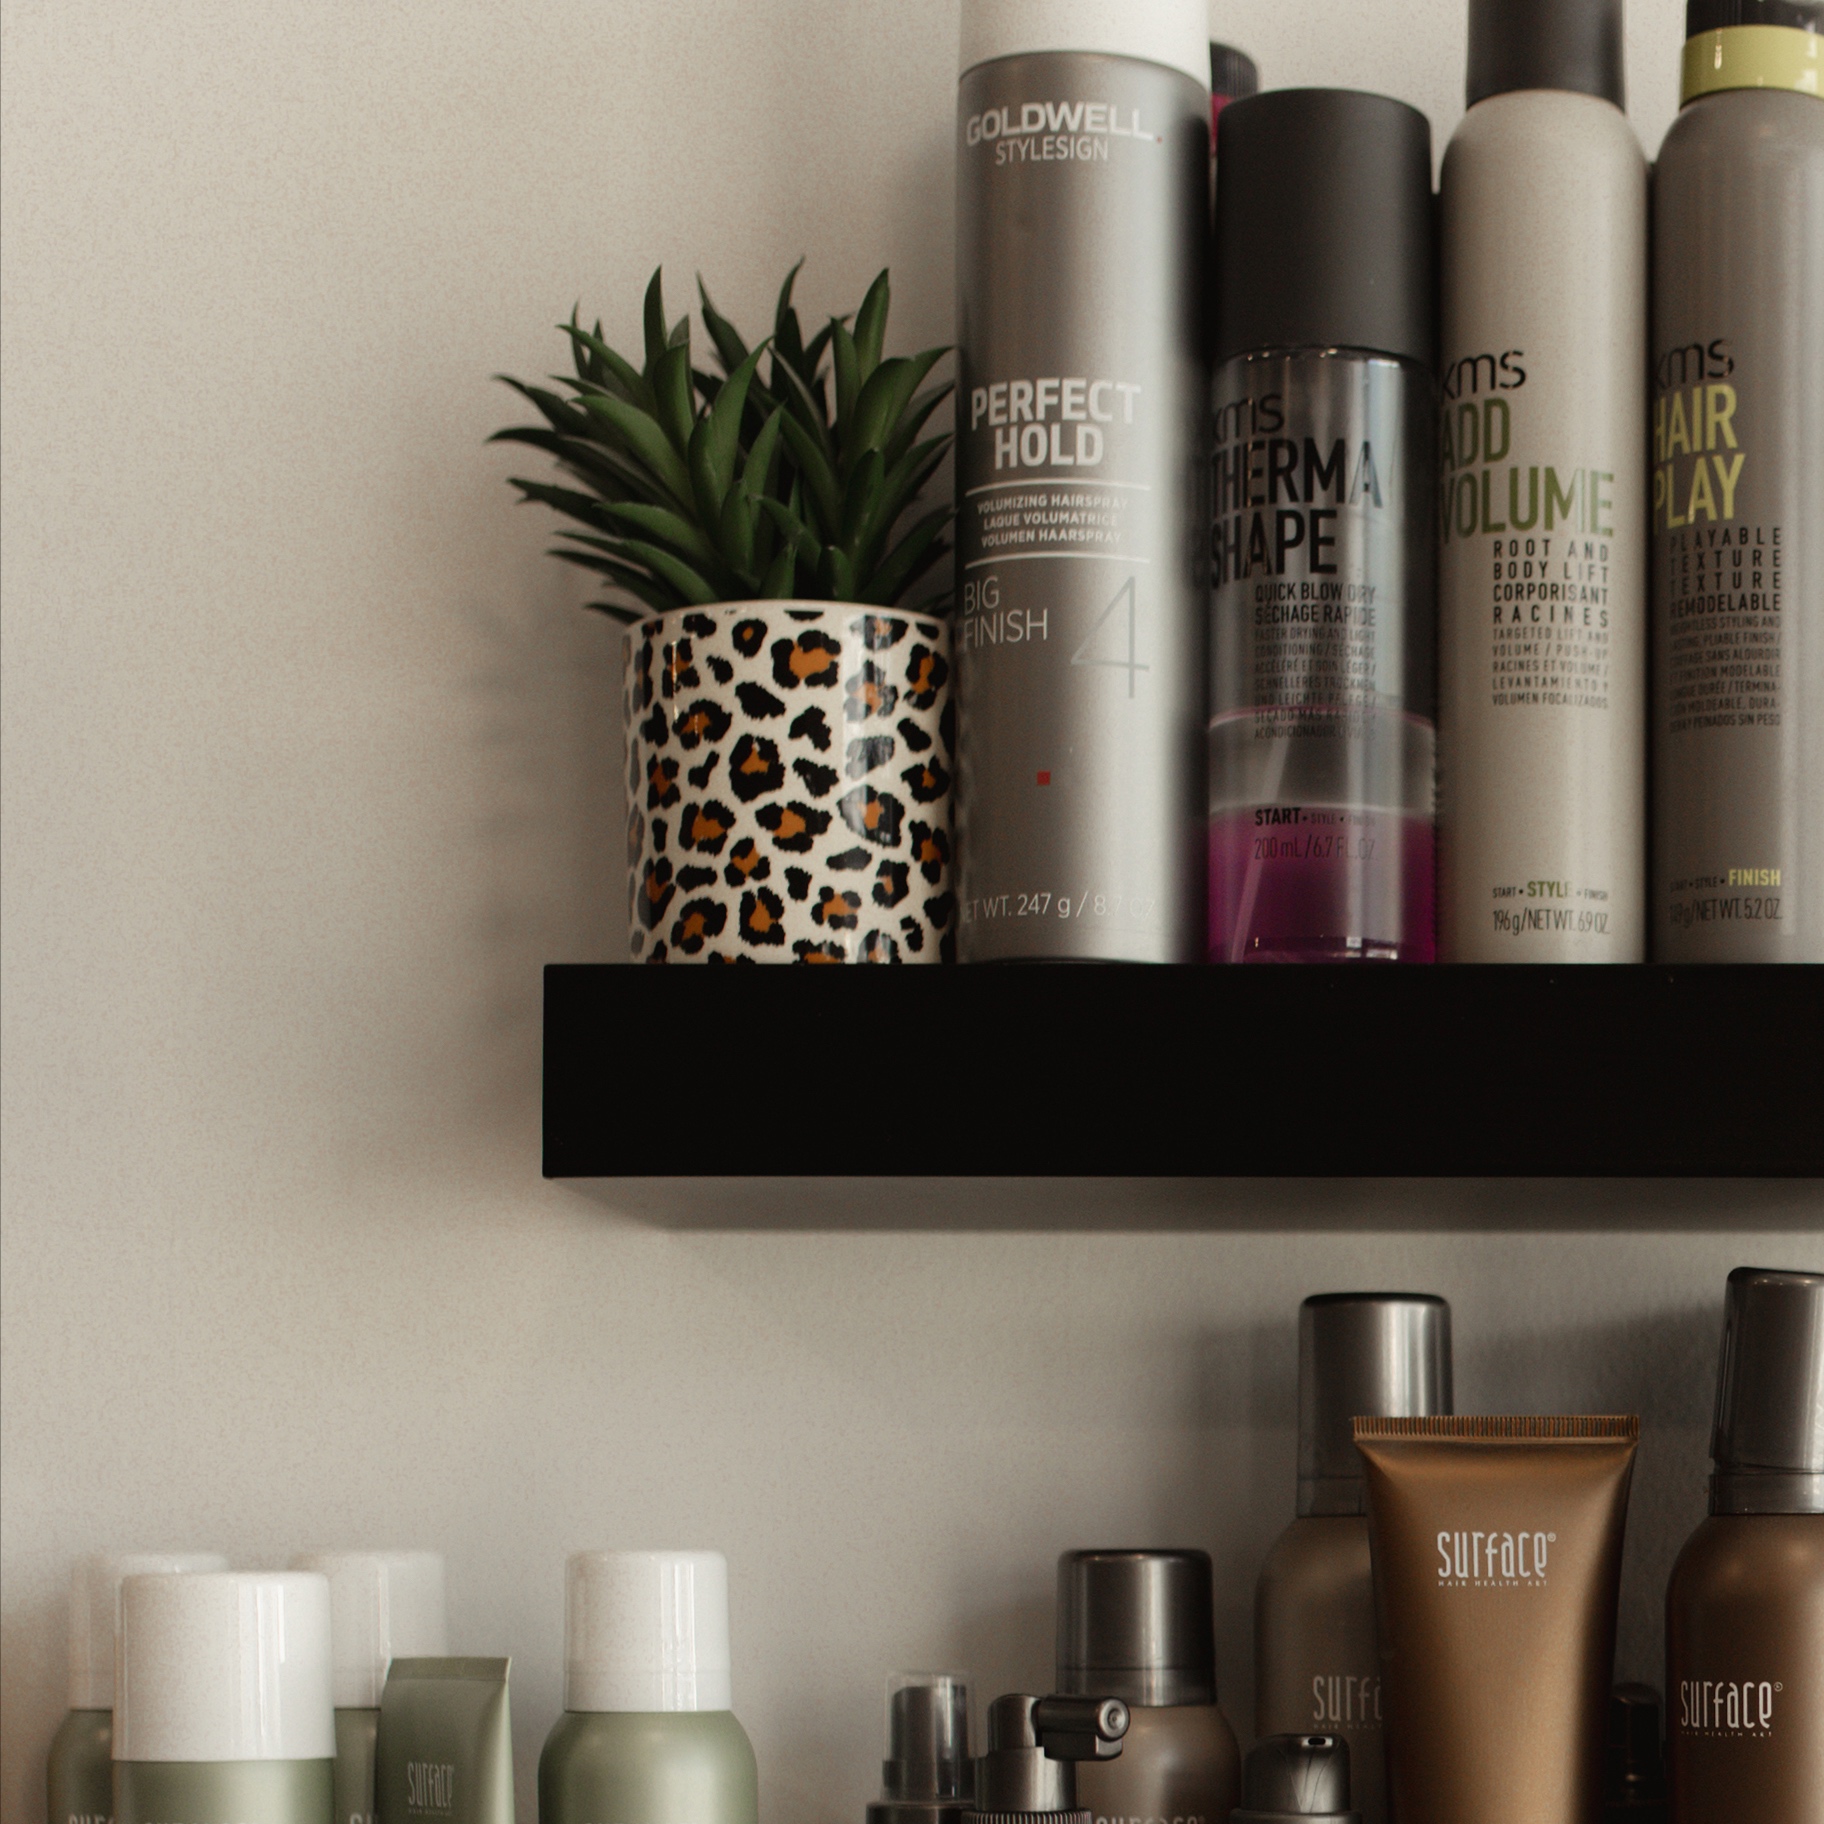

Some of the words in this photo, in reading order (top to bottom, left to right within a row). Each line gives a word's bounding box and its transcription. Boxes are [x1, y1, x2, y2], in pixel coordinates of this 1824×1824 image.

[966, 102, 1154, 146] GOLDWELL
[994, 135, 1109, 166] STYLESIGN
[971, 377, 1142, 431] PERFECT
[1442, 397, 1511, 471] ADD
[1653, 382, 1739, 462] HAIR
[994, 422, 1104, 470] HOLD
[1212, 436, 1384, 519] THERMA
[977, 494, 1047, 514] VOLUMIZING
[1051, 493, 1127, 511] HAIRSPRAY
[1441, 466, 1614, 541] VOLUME
[1652, 452, 1746, 531] PLAY
[984, 513, 1020, 530] LAQUE
[1024, 511, 1118, 528] VOLUMATRICE
[981, 529, 1035, 548] VOLUMEN
[1039, 529, 1122, 544] HAARSPRAY
[1211, 508, 1338, 590] SHAPE
[1493, 538, 1551, 559] ROOT
[1567, 540, 1608, 562] AND
[1669, 526, 1781, 553] PLAYABLE
[1493, 560, 1549, 580] BODY
[1563, 562, 1608, 583] LIFT
[1669, 549, 1781, 577] TEXTURE
[964, 575, 1000, 616] BIG
[1254, 582, 1297, 603] QUICK
[1300, 582, 1344, 601] BLOW
[1493, 582, 1608, 606] CORPORISANT
[1669, 571, 1781, 598] TEXTURE
[1493, 604, 1608, 628] RACINES
[1669, 593, 1781, 619] REMODELABLE
[964, 607, 1049, 650] FINISH
[1071, 575, 1150, 699] 4
[1493, 626, 1552, 641] TARGETED
[1492, 643, 1539, 658] VOLUME
[1493, 659, 1539, 674] RACINES
[1543, 659, 1556, 672] ET
[1492, 692, 1539, 707] VOLUMEN
[1255, 807, 1302, 826] START
[1728, 868, 1781, 887] FINISH
[1017, 892, 1051, 916] 247
[1057, 897, 1071, 918] g
[1436, 1531, 1547, 1578] surface
[1680, 1680, 1772, 1729] surface
